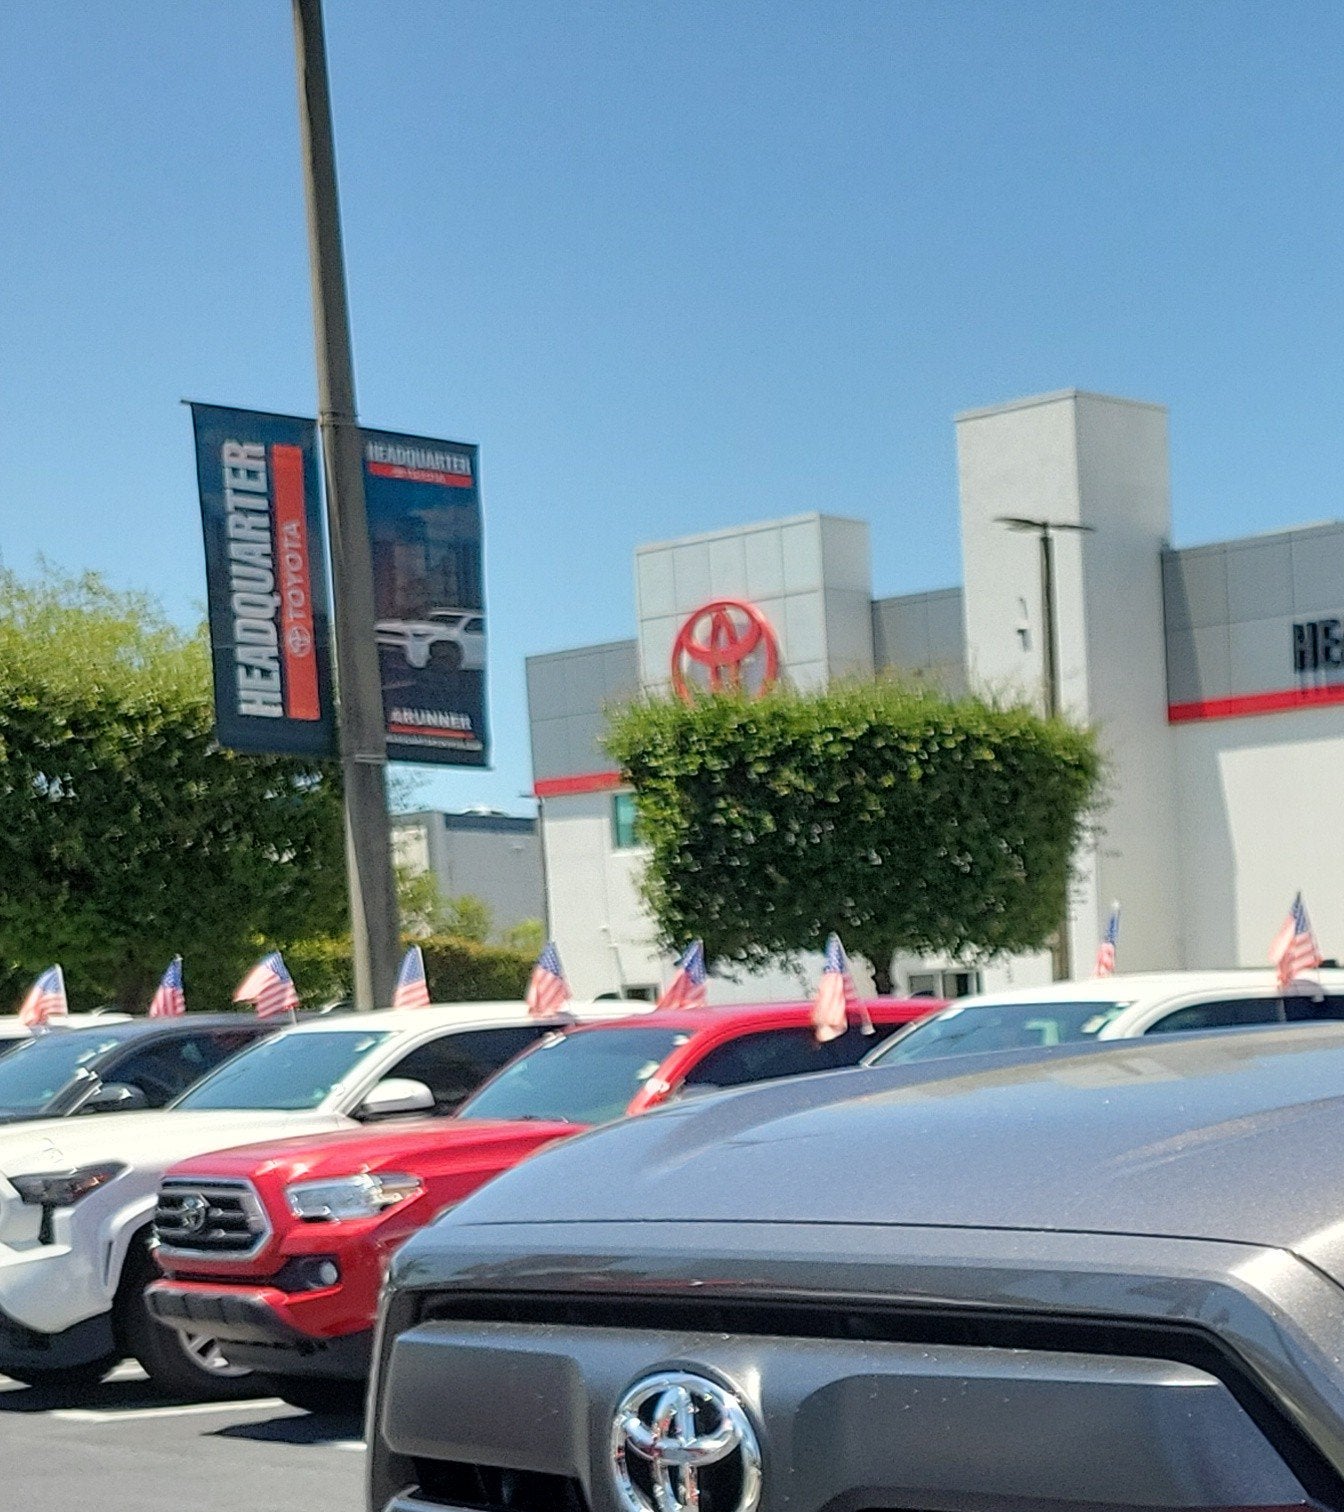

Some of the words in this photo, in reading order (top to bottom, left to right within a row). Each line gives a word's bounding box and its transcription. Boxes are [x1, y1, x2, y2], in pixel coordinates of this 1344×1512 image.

[366, 440, 471, 475] HEADQUARTER
[222, 439, 284, 718] HEADQUARTER
[281, 518, 306, 621] TOYOTA
